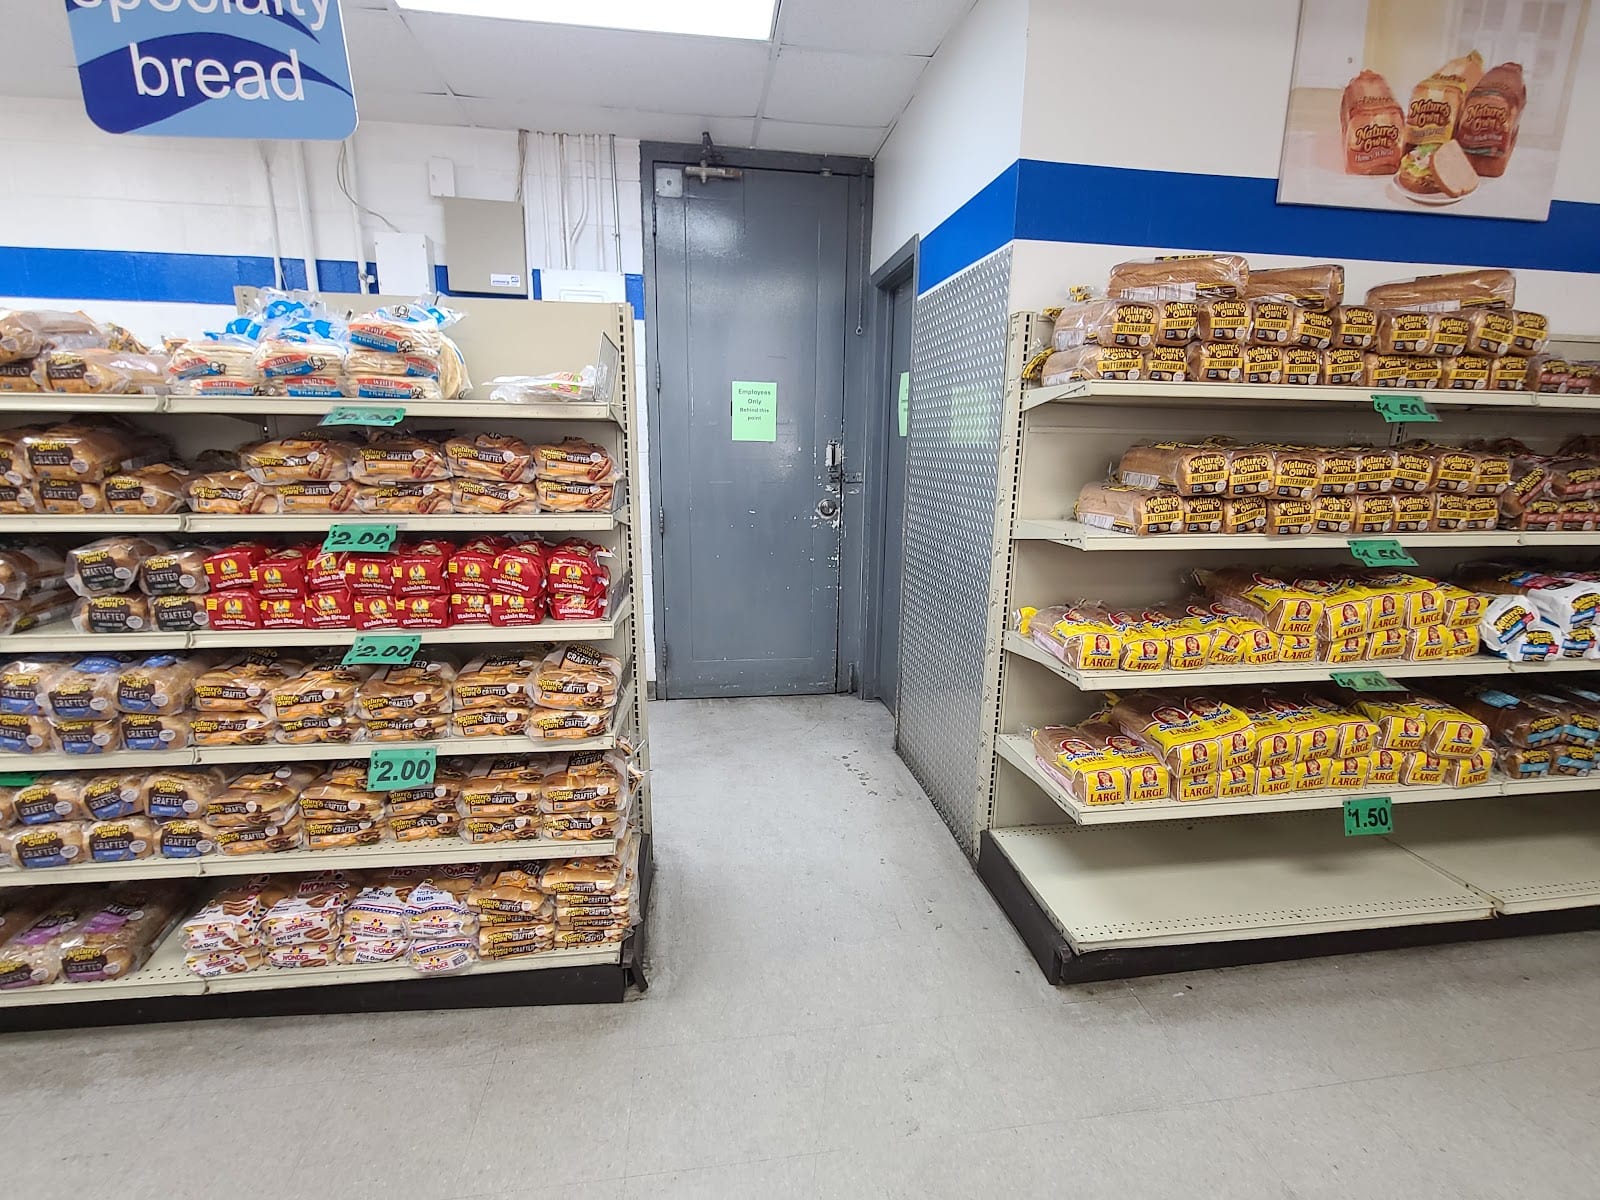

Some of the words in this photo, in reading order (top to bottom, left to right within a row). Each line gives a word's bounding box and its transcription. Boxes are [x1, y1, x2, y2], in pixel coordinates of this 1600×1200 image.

[129, 42, 305, 101] bread
[1411, 99, 1451, 116] Nature's
[1417, 113, 1440, 128] Own
[1473, 119, 1498, 131] Own
[1356, 124, 1398, 141] Nature's
[1363, 137, 1387, 153] Own
[1212, 300, 1246, 315] Nature's
[1220, 308, 1238, 317] Own
[1259, 304, 1288, 316] Nature's
[1117, 306, 1153, 322] Nature's
[1125, 314, 1145, 323] Own
[1265, 310, 1282, 319] Own
[1352, 316, 1368, 324] Own
[1116, 325, 1151, 333] BUTTERBREAD
[1446, 326, 1463, 334] Own
[1153, 347, 1185, 359] Nature's
[1208, 344, 1240, 356] Nature's
[1215, 350, 1233, 359] Own
[1288, 349, 1317, 361] Nature's
[1162, 353, 1180, 361] Own
[1295, 356, 1311, 364] Own
[1190, 458, 1225, 472] Nature's
[1198, 464, 1219, 473] Own
[1232, 458, 1268, 474] Nature's
[1283, 462, 1317, 475] Nature's
[1324, 459, 1357, 472] Nature's
[1332, 465, 1350, 473] Own
[1360, 457, 1392, 470] Nature's
[1367, 463, 1385, 471] Own
[1240, 465, 1261, 475] Own
[1289, 468, 1309, 477] Own
[1191, 473, 1225, 482] BUTTERBREAD
[1525, 476, 1541, 491] Own
[1145, 497, 1179, 511] Nature's
[1154, 504, 1172, 512] Own
[1188, 497, 1221, 510] Nature's
[1196, 503, 1214, 512] Own
[92, 613, 125, 621] CRAFTED
[159, 611, 192, 620] CRAFTED
[1414, 612, 1440, 625] LARGE
[1281, 623, 1313, 632] LARGE
[1372, 617, 1399, 629] LARGE
[1248, 650, 1277, 663] LARGE
[1283, 650, 1313, 659] LARGE
[1373, 646, 1401, 656] LARGE
[1083, 657, 1116, 667] LARGE
[1128, 660, 1160, 670] LARGE
[1174, 657, 1205, 667] LARGE
[127, 730, 158, 738] CRAFTED
[1344, 742, 1370, 756] LARGE
[1441, 743, 1475, 755] LARGE
[1225, 752, 1254, 767] LARGE
[374, 760, 430, 781] $2.00
[1182, 762, 1214, 776] LARGE
[1331, 777, 1361, 786] LARGE
[1412, 772, 1440, 782] LARGE
[1462, 772, 1487, 785] LARGE
[1261, 782, 1290, 793] LARGE
[1296, 777, 1324, 789] LARGE
[1133, 788, 1164, 799] LARGE
[1183, 785, 1214, 798] LARGE
[1222, 783, 1250, 796] LARGE
[152, 797, 182, 806] CRAFTED
[1090, 791, 1122, 802] LARGE
[1348, 807, 1388, 828] $1.50
[94, 840, 129, 850] CRAFTED
[164, 838, 196, 847] CRAFTED
